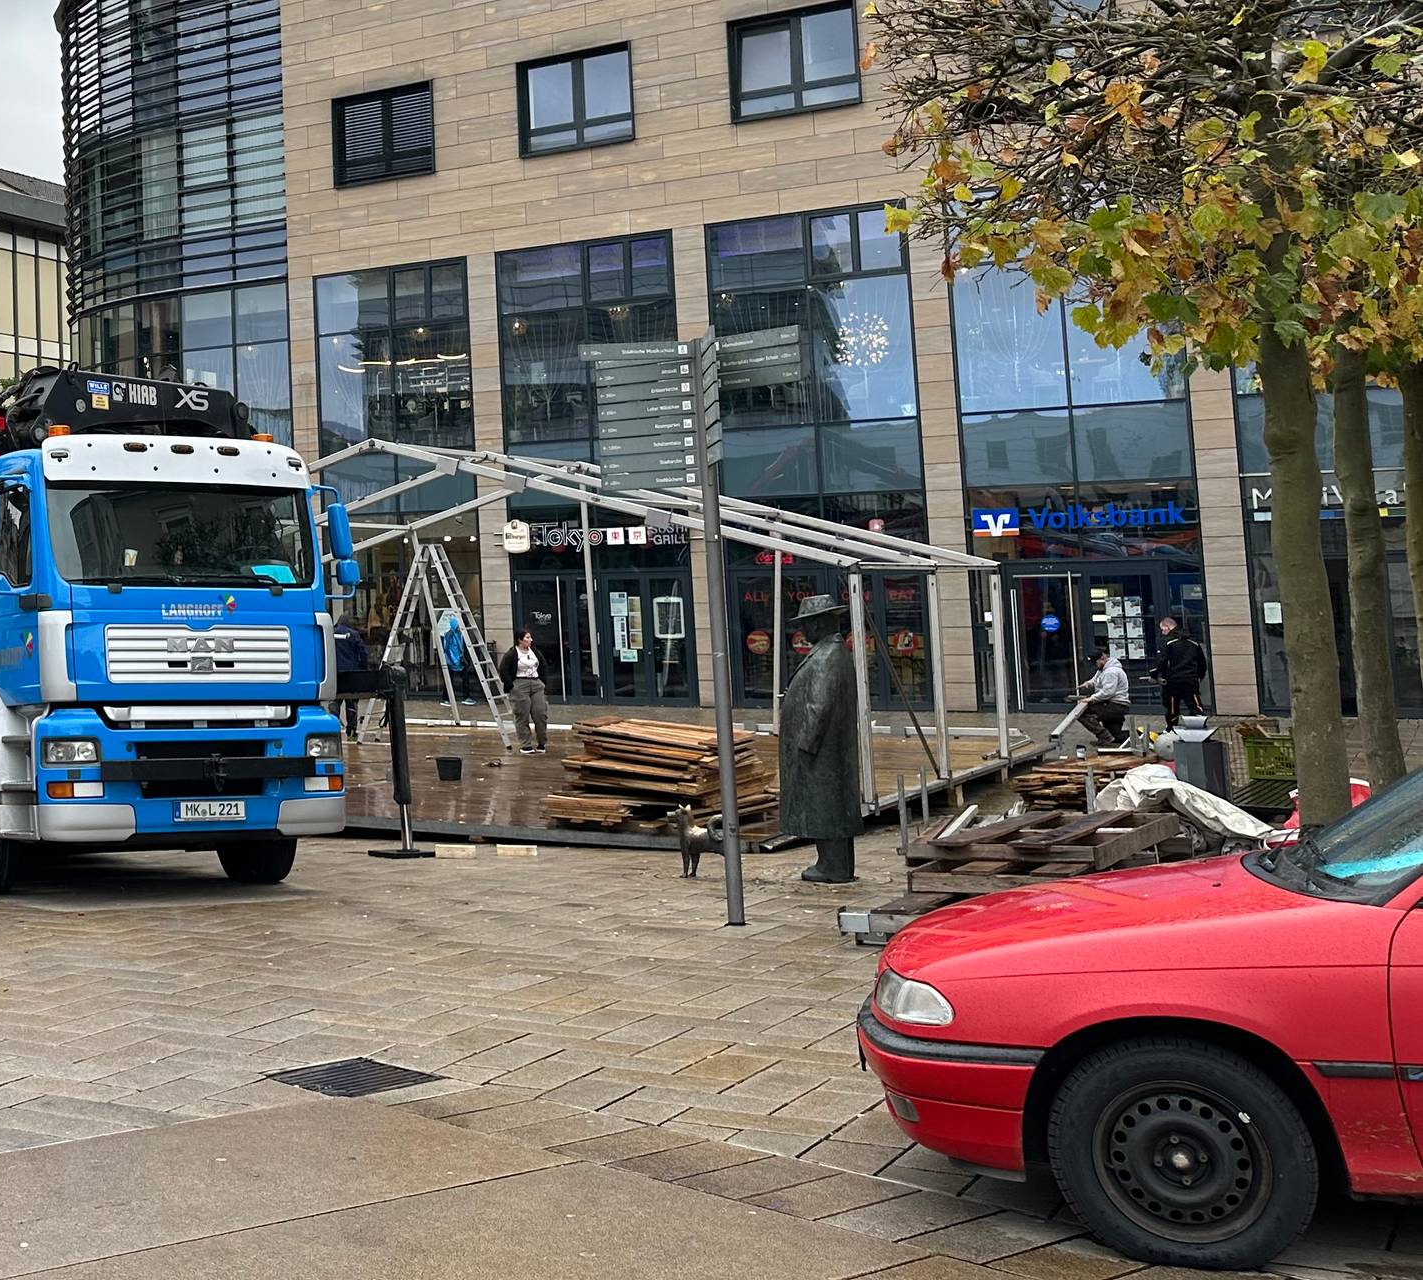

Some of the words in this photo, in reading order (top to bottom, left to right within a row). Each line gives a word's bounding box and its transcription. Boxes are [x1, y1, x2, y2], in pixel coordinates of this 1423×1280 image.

[128, 383, 157, 406] HIAB
[174, 387, 209, 411] XS
[1028, 501, 1185, 529] Volksbank
[531, 521, 603, 552] Tokyo
[653, 534, 689, 545] GRILL
[744, 591, 768, 602] ALL
[888, 589, 915, 601] EAT
[161, 603, 223, 616] LANGHOFF
[167, 637, 234, 653] MAN
[185, 803, 201, 816] MK
[218, 803, 240, 816] 221
